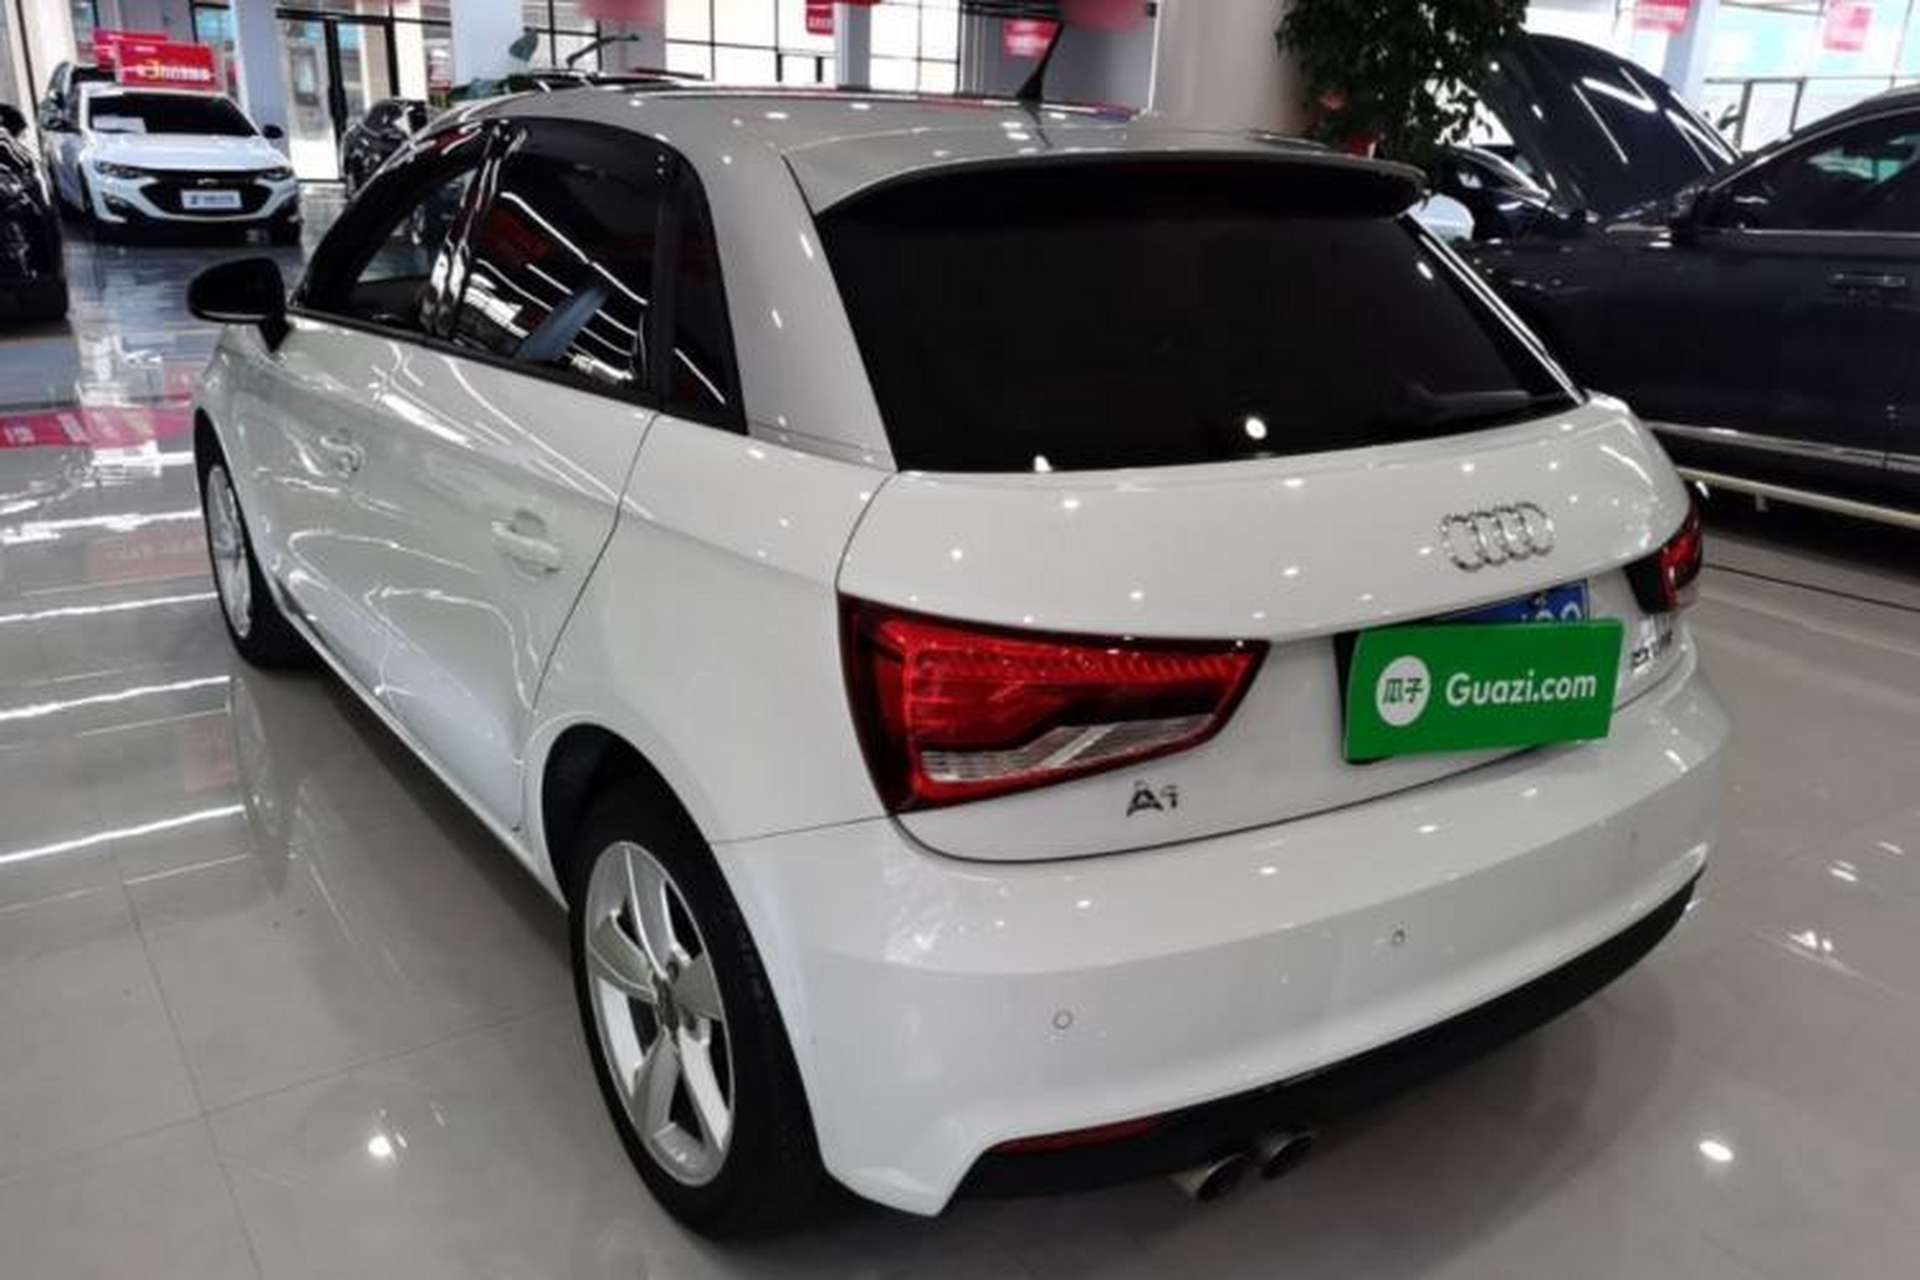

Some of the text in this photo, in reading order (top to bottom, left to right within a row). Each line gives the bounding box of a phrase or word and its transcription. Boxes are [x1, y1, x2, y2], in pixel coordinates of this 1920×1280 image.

[1383, 677, 1424, 704] 瓜子
[1445, 668, 1597, 707] Guazi.com
[1126, 780, 1179, 817] A1
